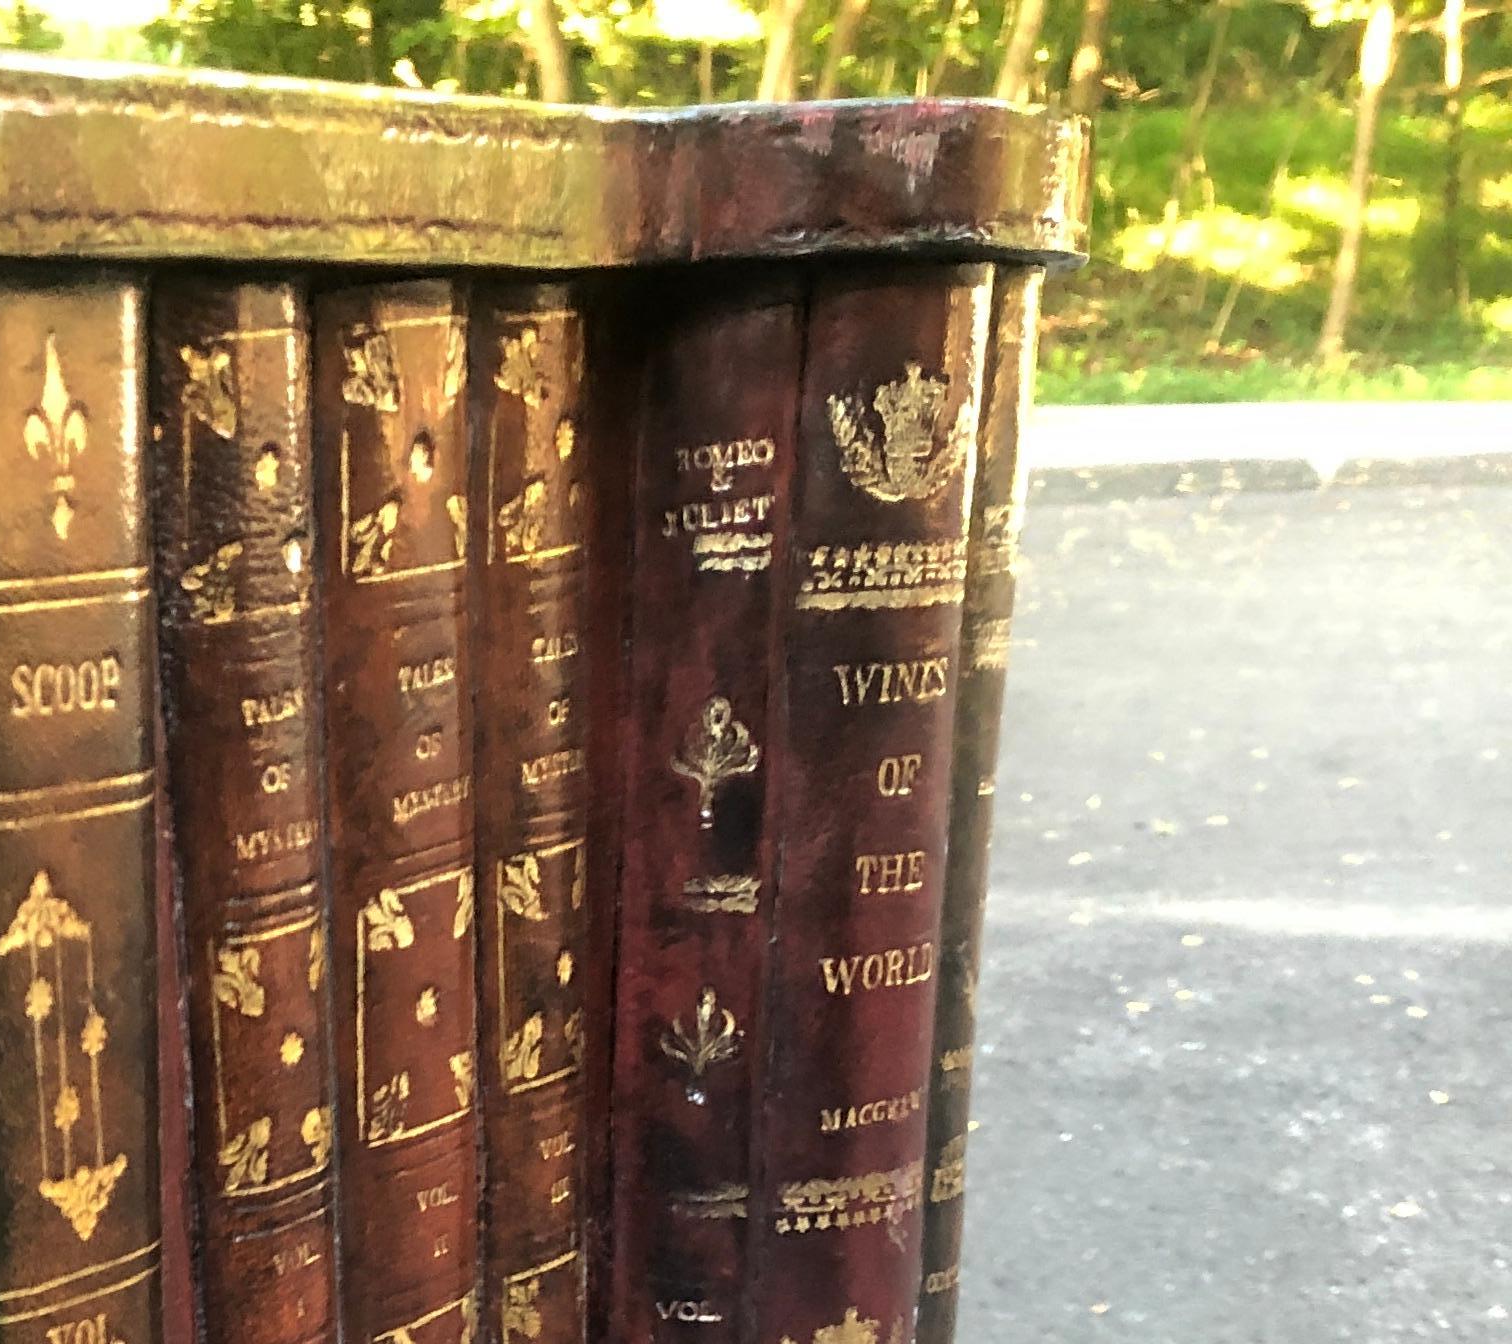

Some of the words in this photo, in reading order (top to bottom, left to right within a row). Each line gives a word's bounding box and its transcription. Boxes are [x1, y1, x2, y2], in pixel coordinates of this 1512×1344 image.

[675, 438, 775, 472] ROMEO
[662, 496, 776, 538] JULIET
[11, 652, 121, 718] SCOOP
[398, 657, 455, 692] TALES
[548, 698, 571, 727] OF
[416, 731, 442, 760] OF
[261, 762, 292, 794] OF
[878, 754, 923, 797] OF
[855, 851, 926, 895] THE
[819, 942, 935, 995] WORLD
